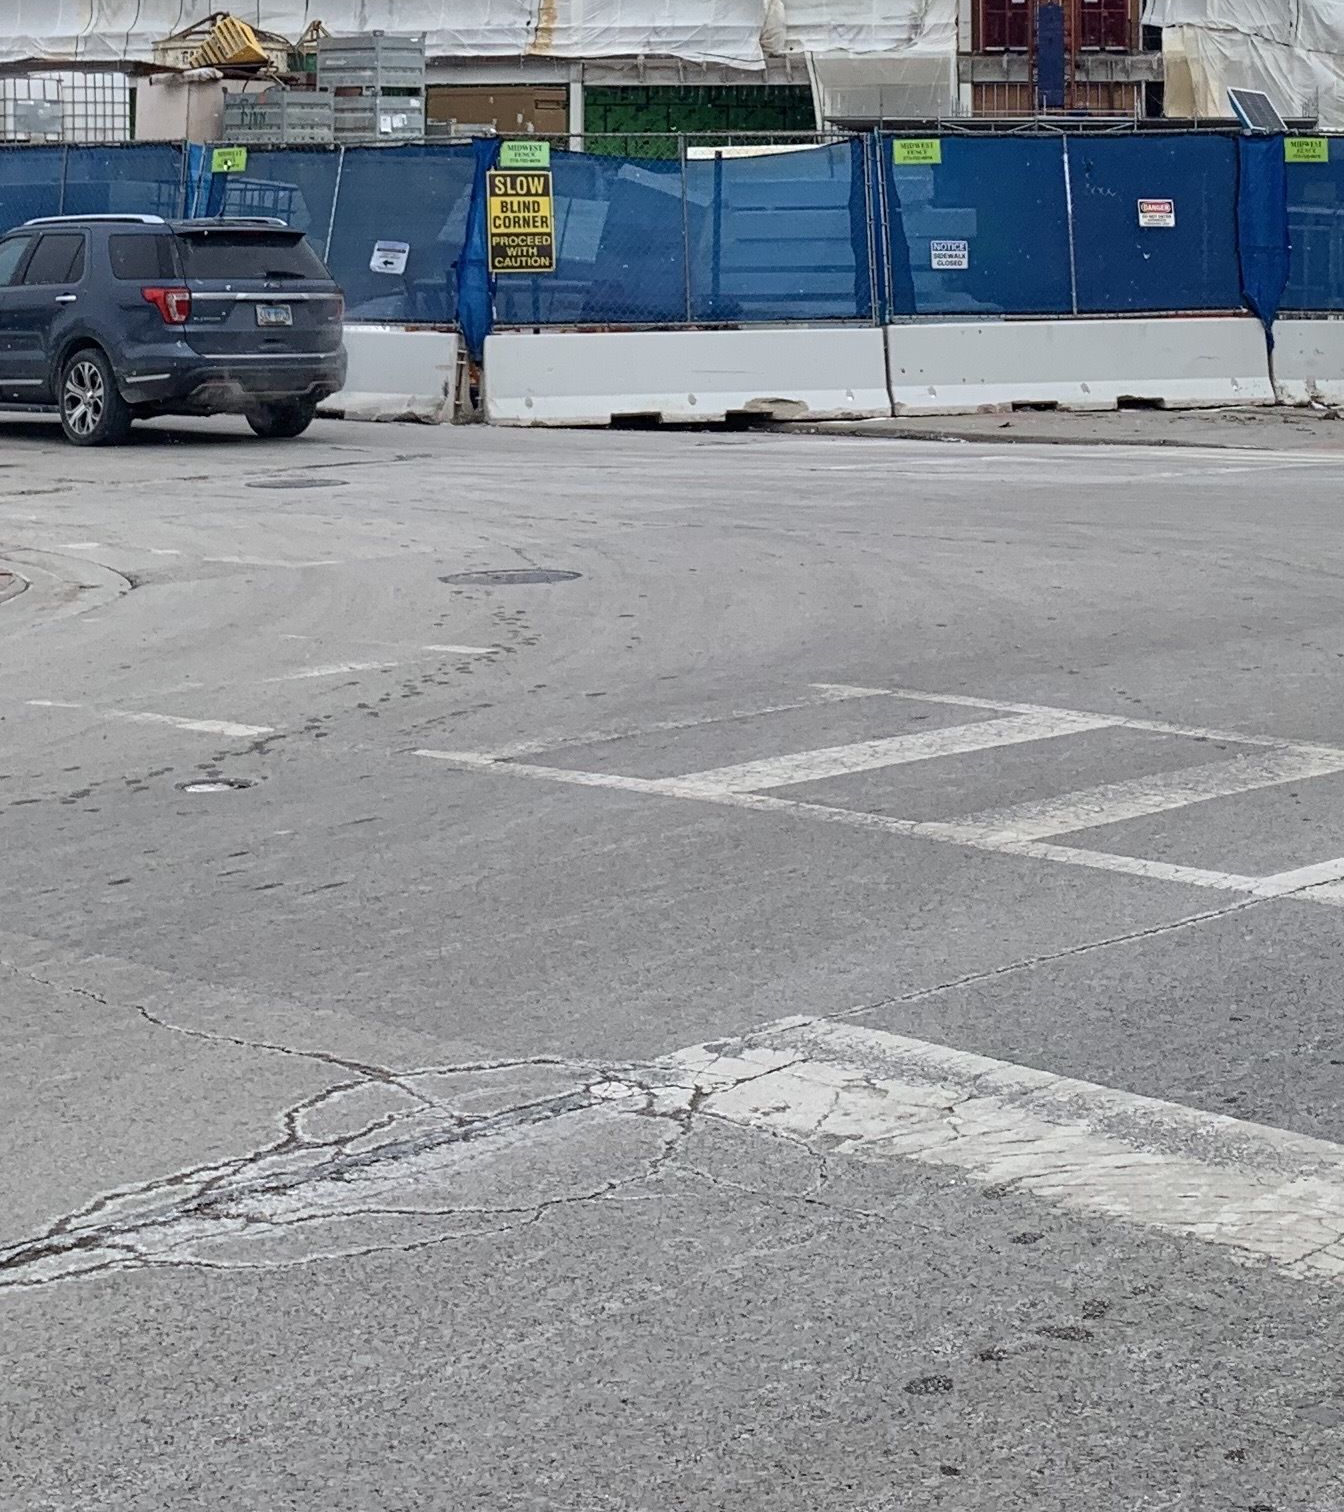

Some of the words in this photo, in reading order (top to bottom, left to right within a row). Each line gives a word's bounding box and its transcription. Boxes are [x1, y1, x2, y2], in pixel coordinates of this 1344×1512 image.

[494, 176, 544, 195] SLOW
[500, 200, 541, 214] BLIND
[493, 215, 549, 229] CORNER
[492, 236, 551, 246] PROCEED
[506, 247, 538, 257] WITH
[933, 242, 966, 252] NOTICE
[494, 257, 550, 268] CAUTION
[936, 259, 963, 267] CLOSED
